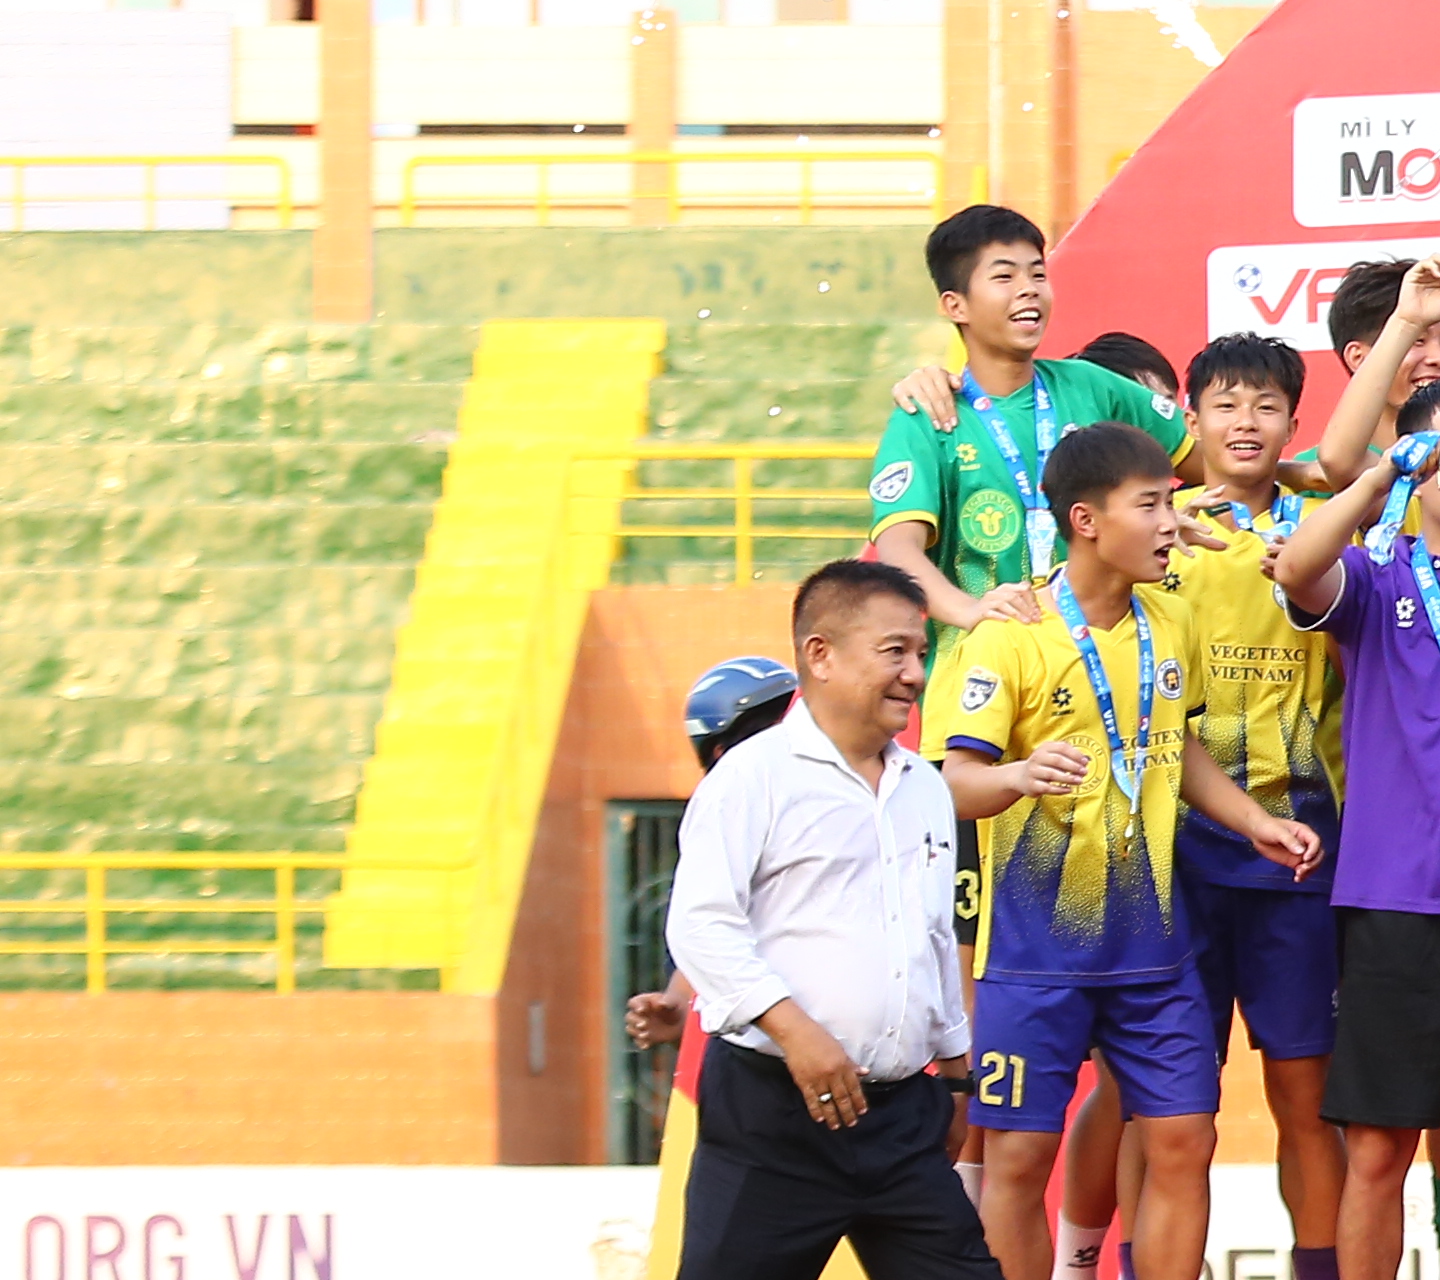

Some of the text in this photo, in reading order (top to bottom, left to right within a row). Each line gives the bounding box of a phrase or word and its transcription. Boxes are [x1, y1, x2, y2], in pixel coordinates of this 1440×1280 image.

[1340, 117, 1417, 139] MÌ LY
[1211, 666, 1293, 682] VIETNAM
[978, 1050, 1027, 1109] 21
